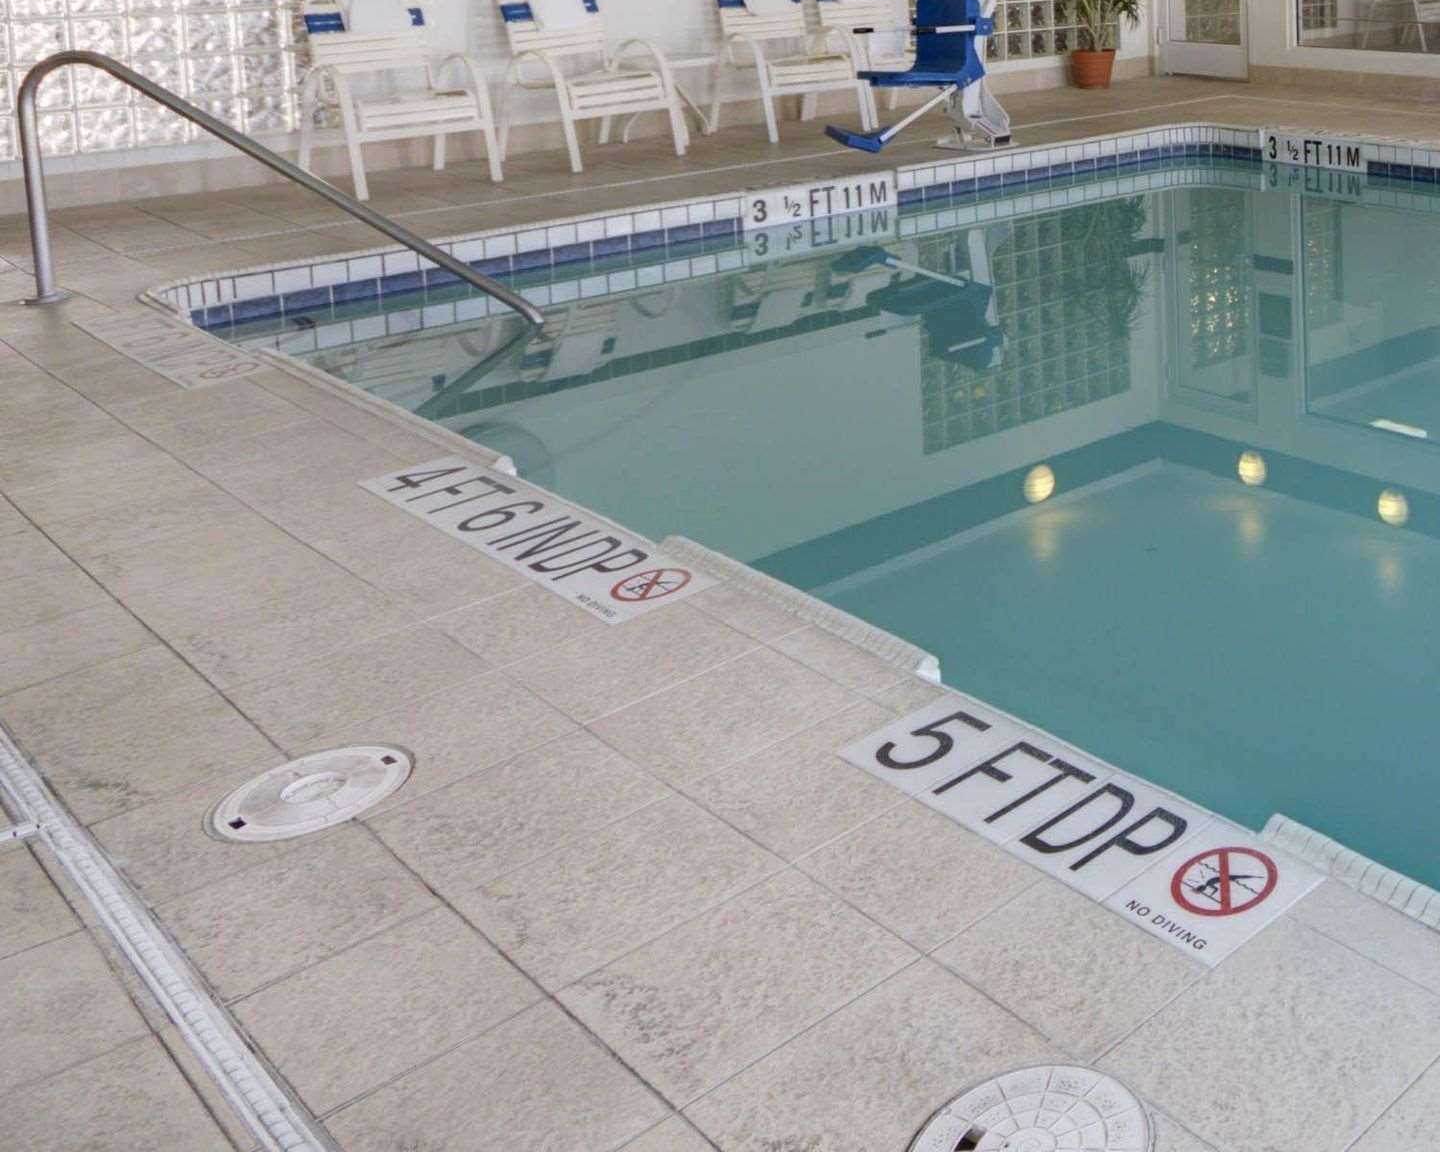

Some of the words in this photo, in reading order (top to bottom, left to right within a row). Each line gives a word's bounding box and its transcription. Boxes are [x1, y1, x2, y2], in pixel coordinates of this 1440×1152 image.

[1269, 135, 1277, 159] 3
[1304, 139, 1322, 165] FT
[753, 199, 768, 222] 3
[809, 186, 835, 217] FT
[387, 466, 468, 492] 4
[875, 710, 992, 770] 5
[1125, 900, 1151, 917] NO
[1151, 914, 1207, 951] DIVING
